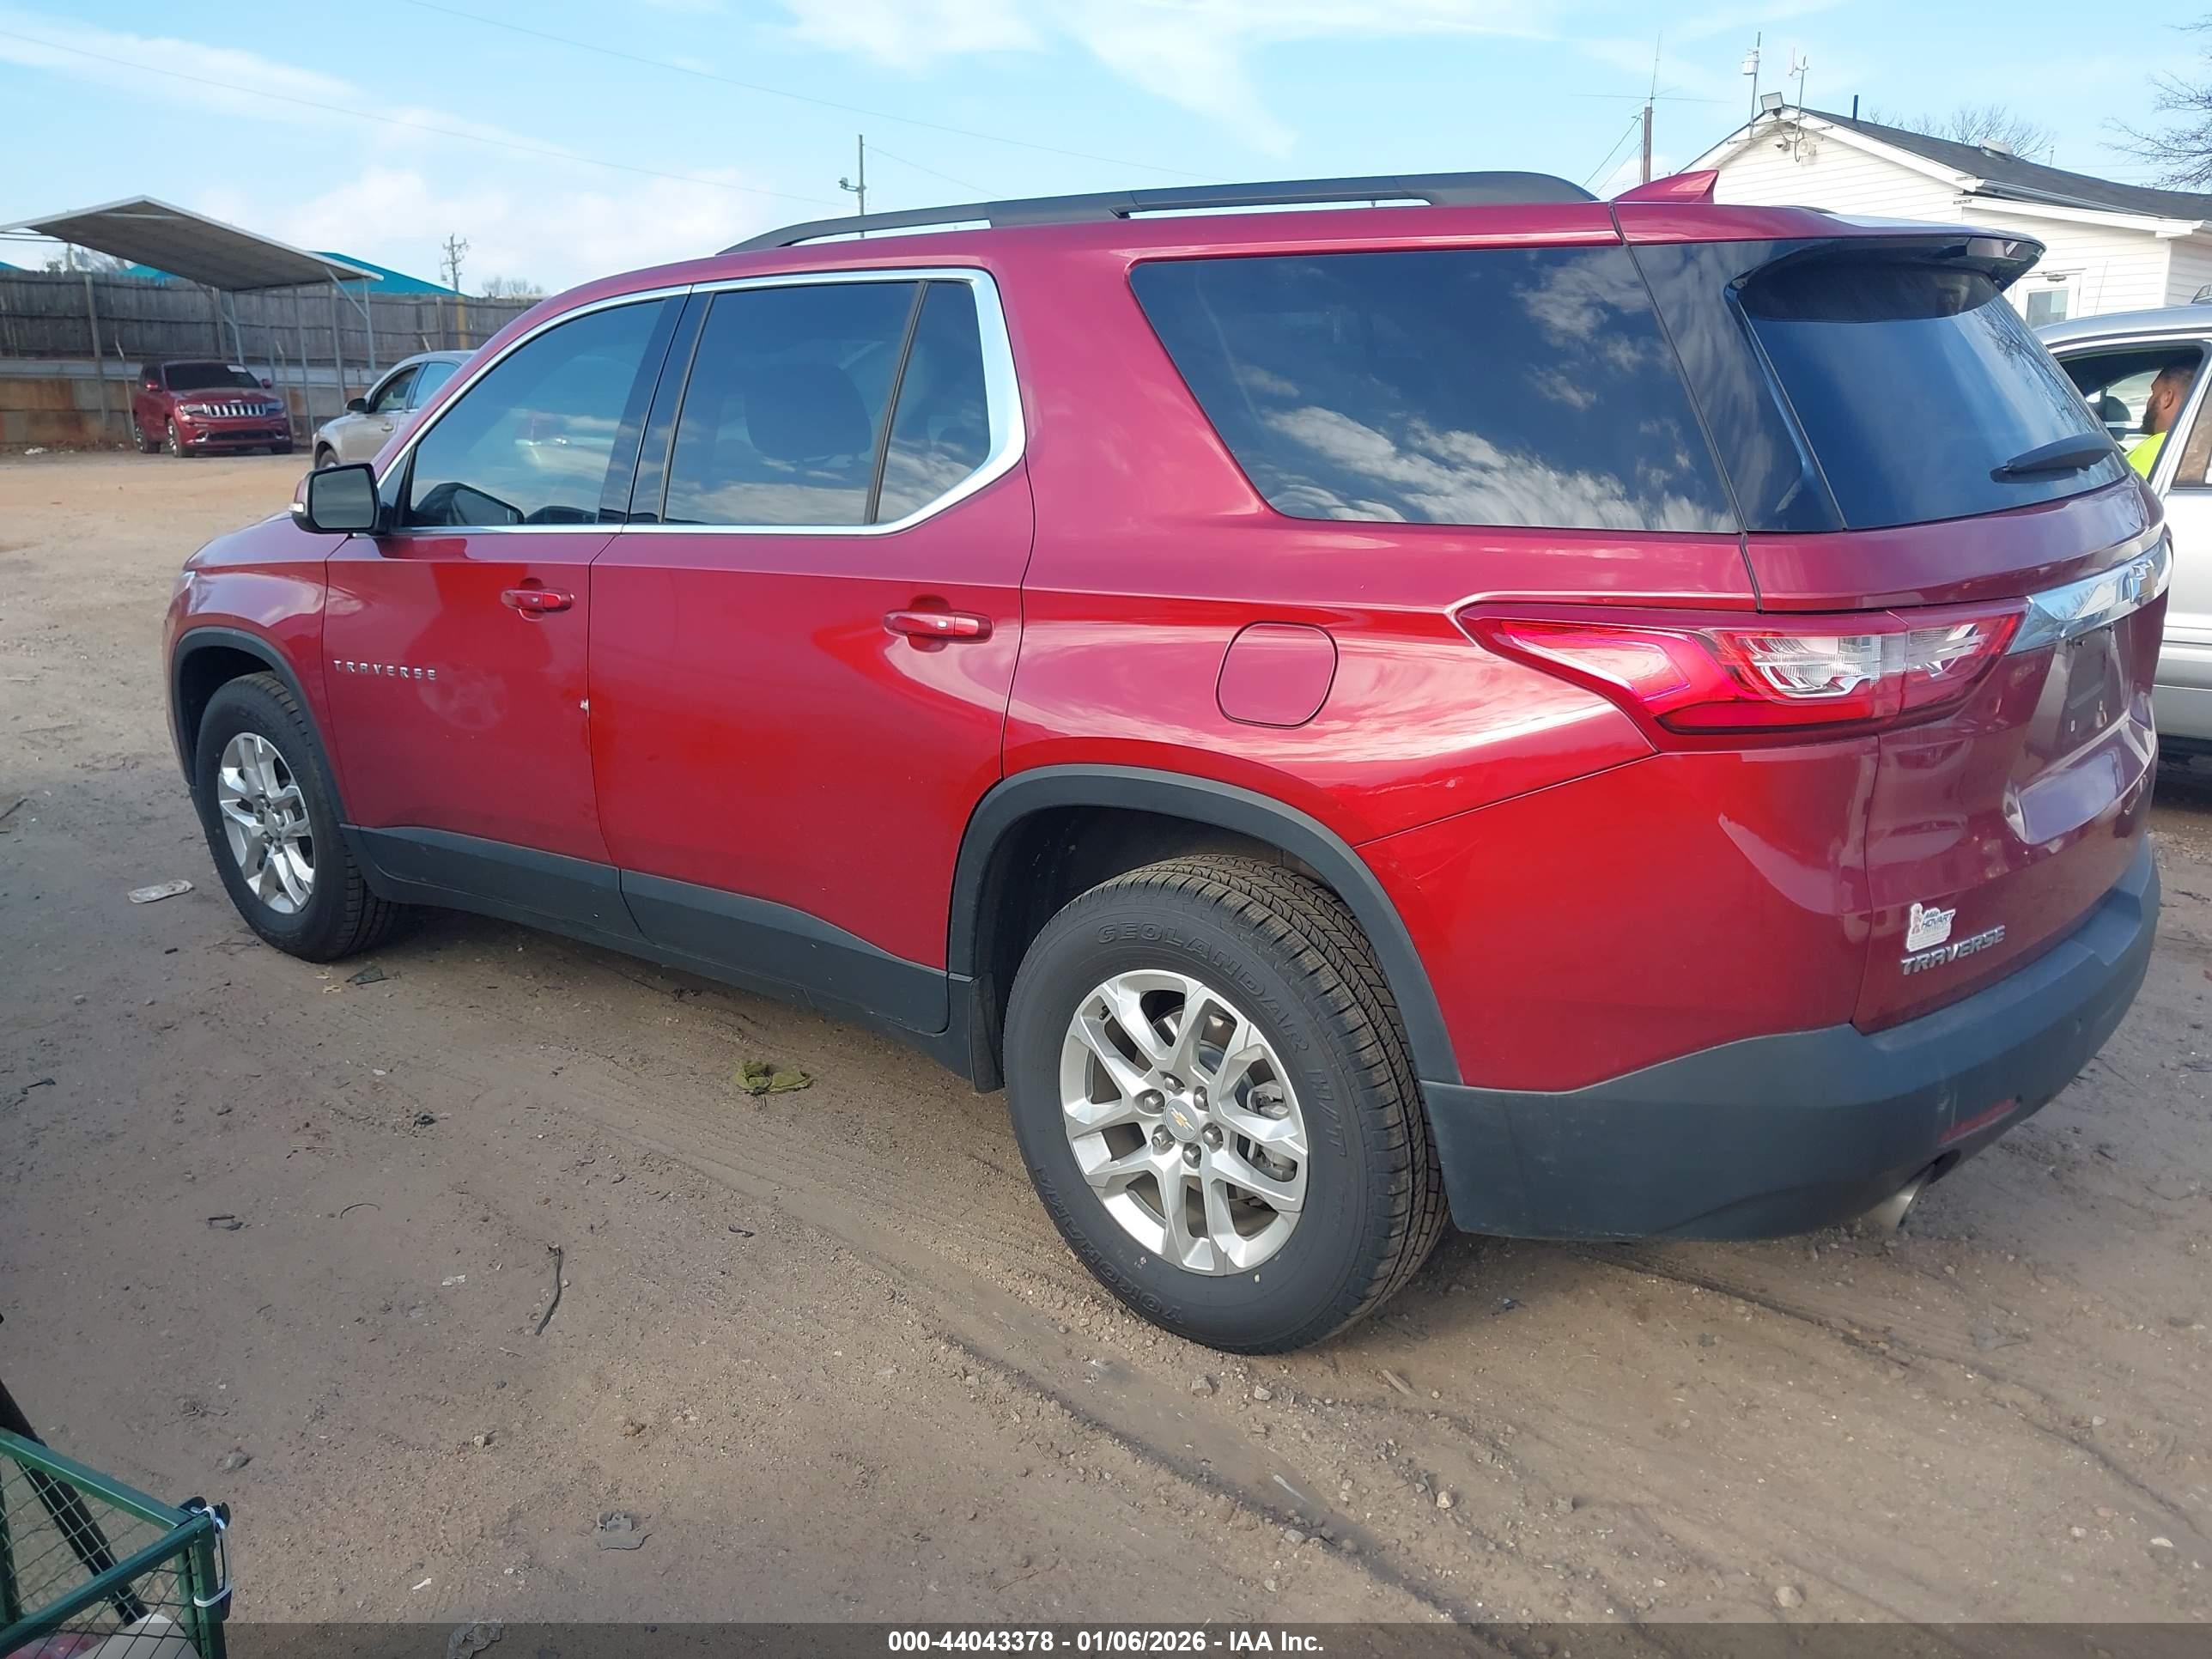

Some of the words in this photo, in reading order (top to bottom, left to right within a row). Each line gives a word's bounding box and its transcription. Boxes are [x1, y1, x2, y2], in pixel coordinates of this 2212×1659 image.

[333, 659, 437, 681] TRAVERSE
[1900, 924, 2006, 975] TRAVERSE
[1097, 921, 1310, 1054] GEOLANDAR
